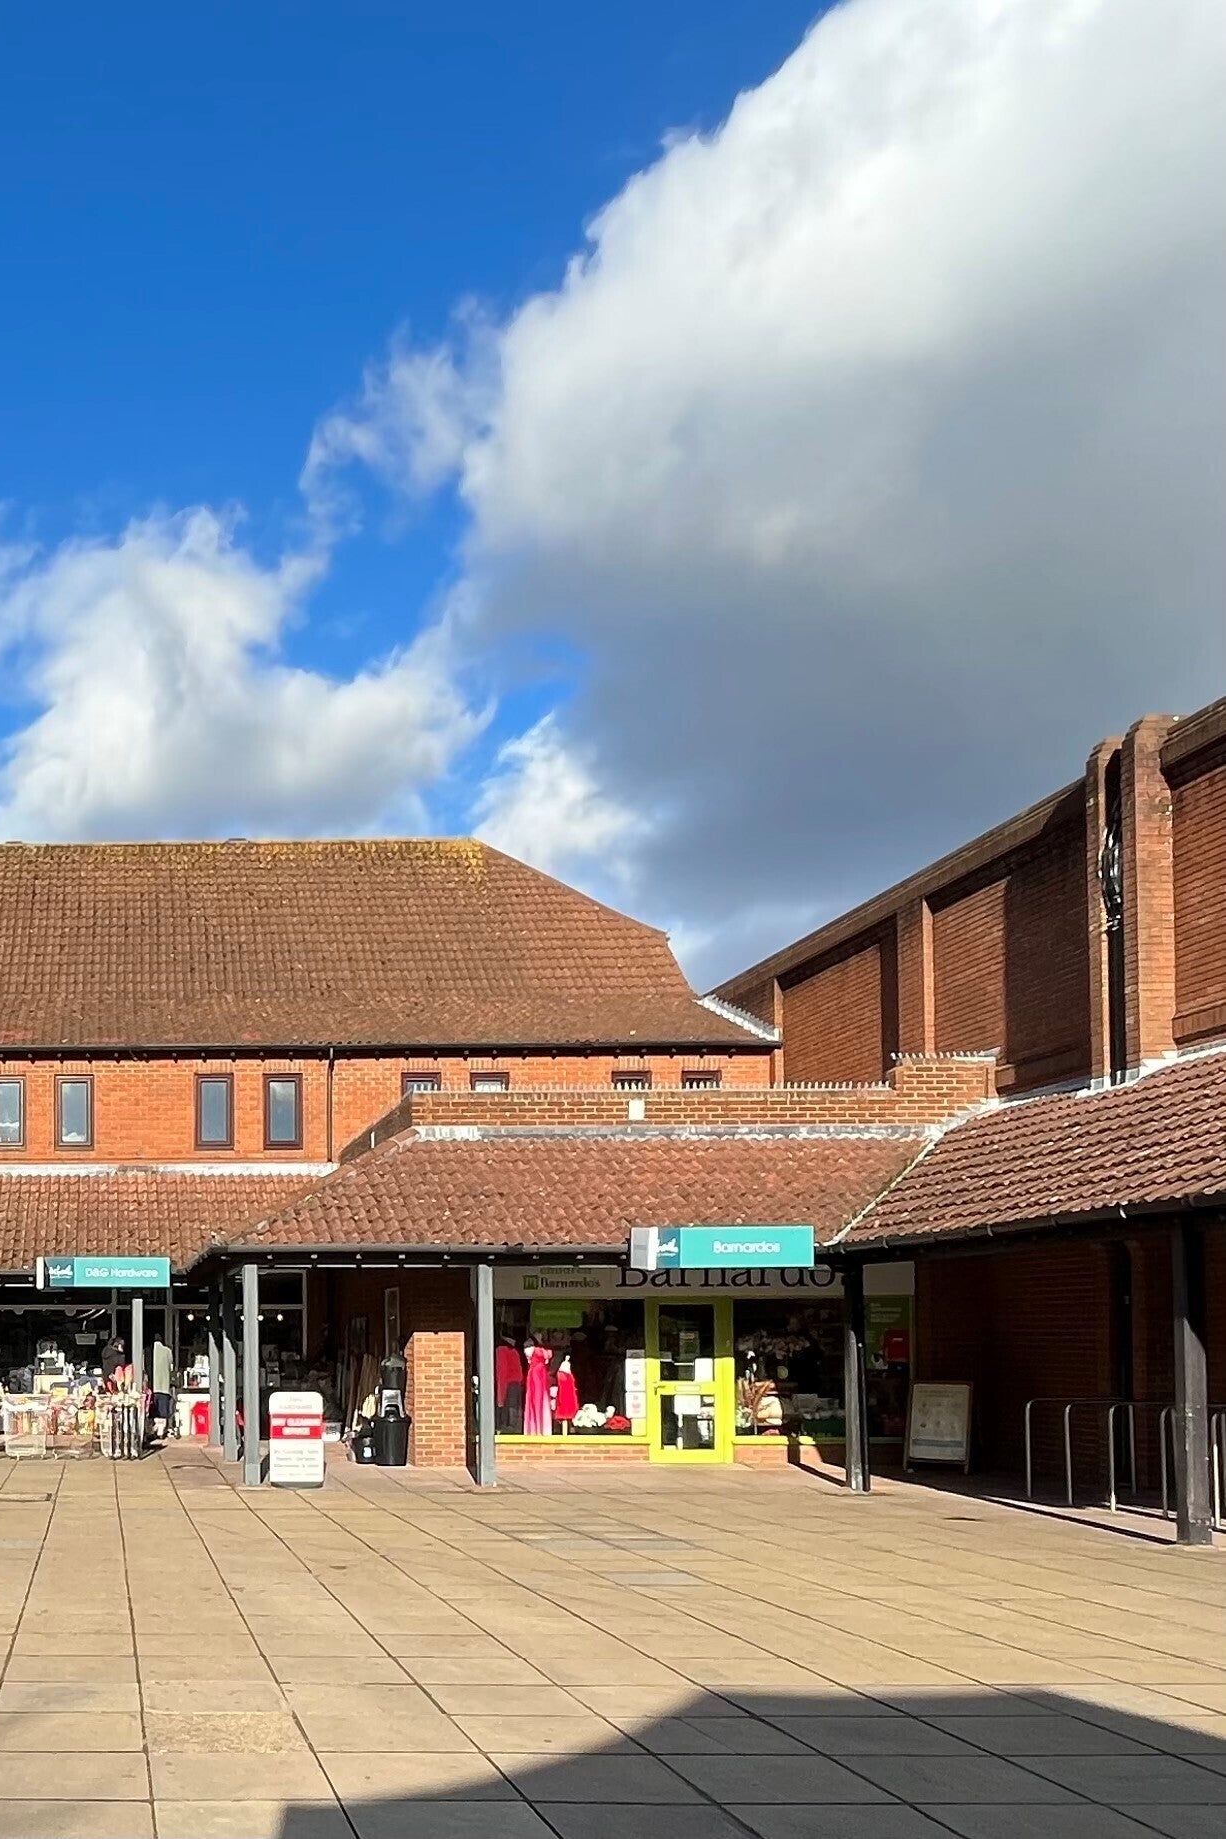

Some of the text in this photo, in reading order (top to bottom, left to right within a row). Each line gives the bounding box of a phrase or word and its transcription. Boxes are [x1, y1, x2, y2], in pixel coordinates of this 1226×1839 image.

[713, 1240, 781, 1253] Barnardos
[111, 1267, 159, 1278] Hardware
[616, 1268, 845, 1288] Barnardo
